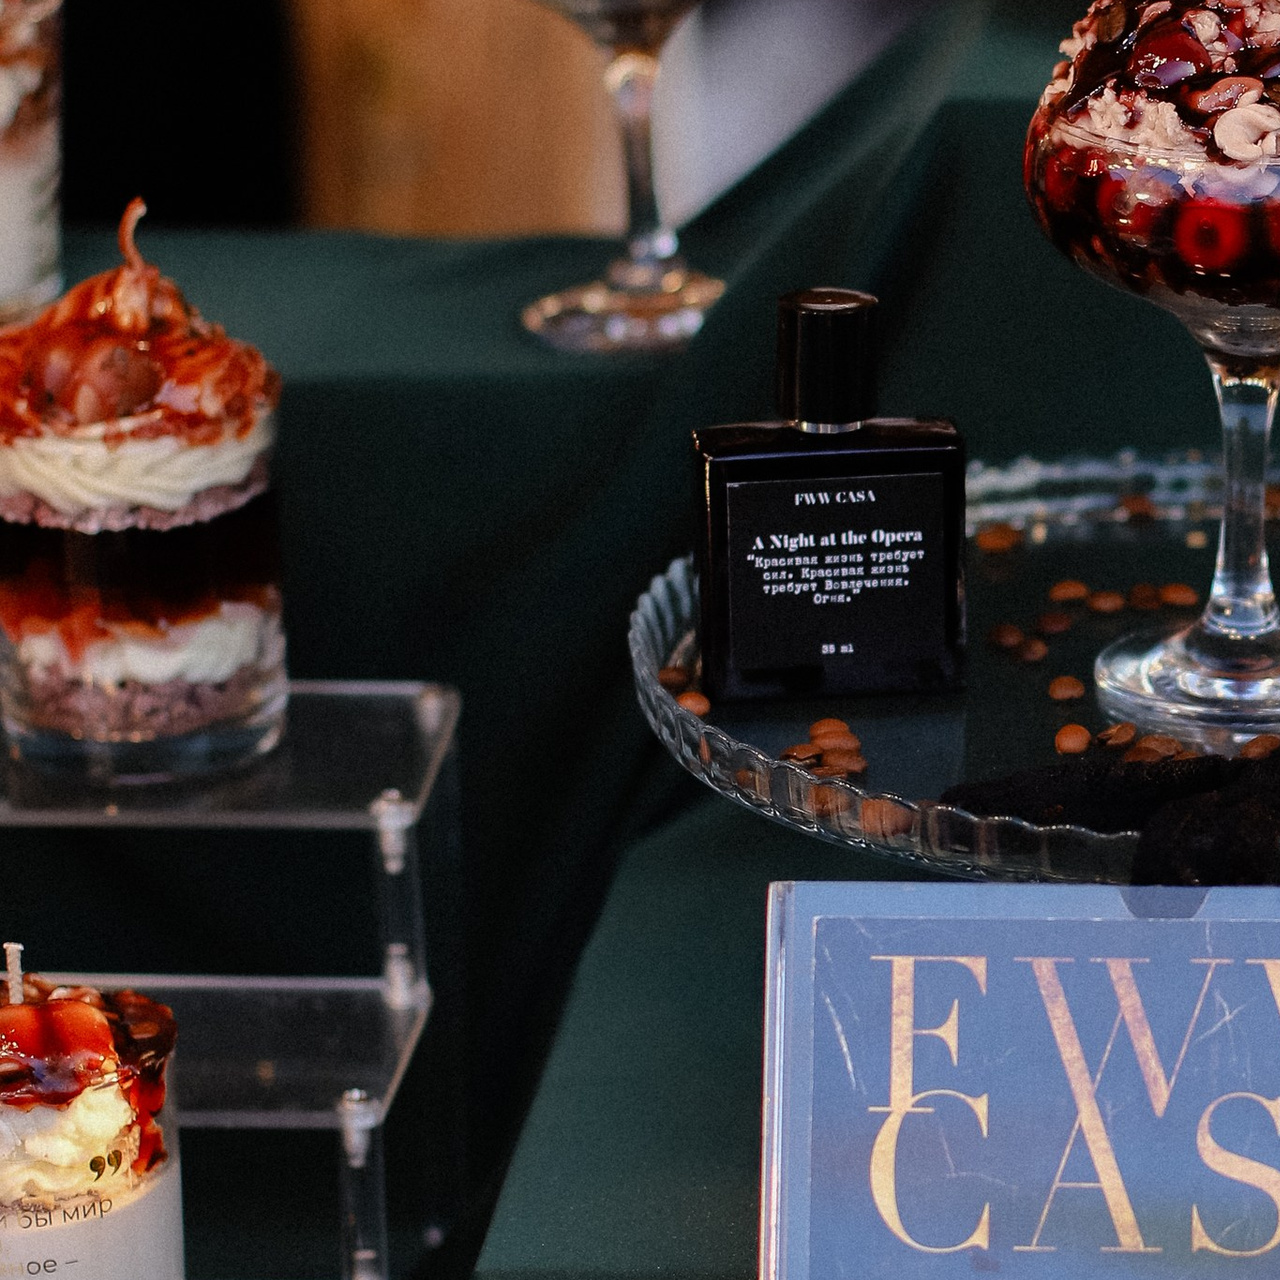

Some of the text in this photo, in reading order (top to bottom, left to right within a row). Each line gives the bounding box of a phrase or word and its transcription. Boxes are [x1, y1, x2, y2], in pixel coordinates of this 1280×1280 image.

[794, 490, 876, 506] FWW CASA
[752, 529, 923, 552] A Night at the Opera
[824, 553, 864, 564] жизнь
[870, 549, 925, 564] требует
[763, 564, 910, 581] сил. Красивая жизнь
[763, 577, 909, 595] требует Вовлечения.
[63, 1198, 113, 1223] мир
